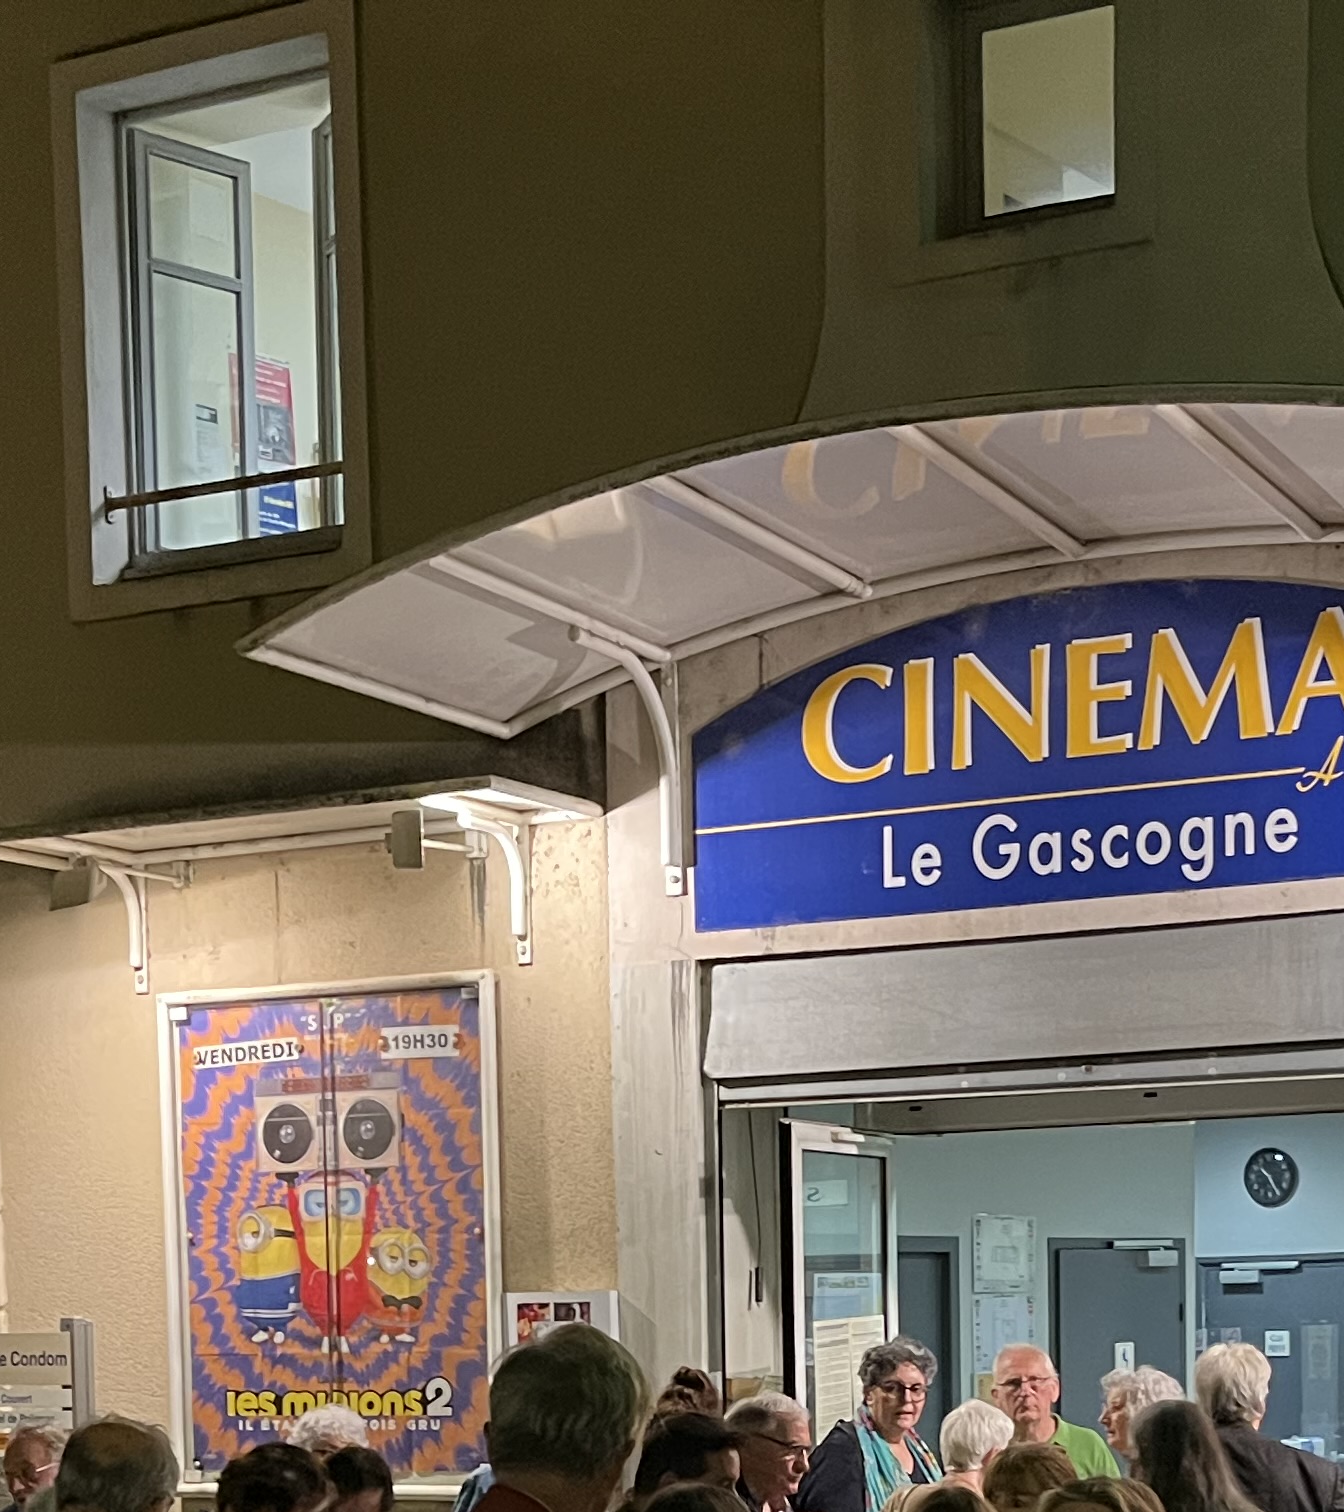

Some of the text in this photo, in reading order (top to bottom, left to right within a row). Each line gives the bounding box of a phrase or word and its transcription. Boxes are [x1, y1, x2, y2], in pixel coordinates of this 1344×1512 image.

[882, 806, 1301, 889] Le Gascogne
[390, 1033, 448, 1051] 19H30
[197, 1041, 295, 1066] VENDREDI
[10, 1351, 68, 1367] Condom
[226, 1390, 277, 1417] les
[425, 1375, 454, 1417] 2
[238, 1420, 254, 1431] IL
[406, 1418, 442, 1432] GRU
